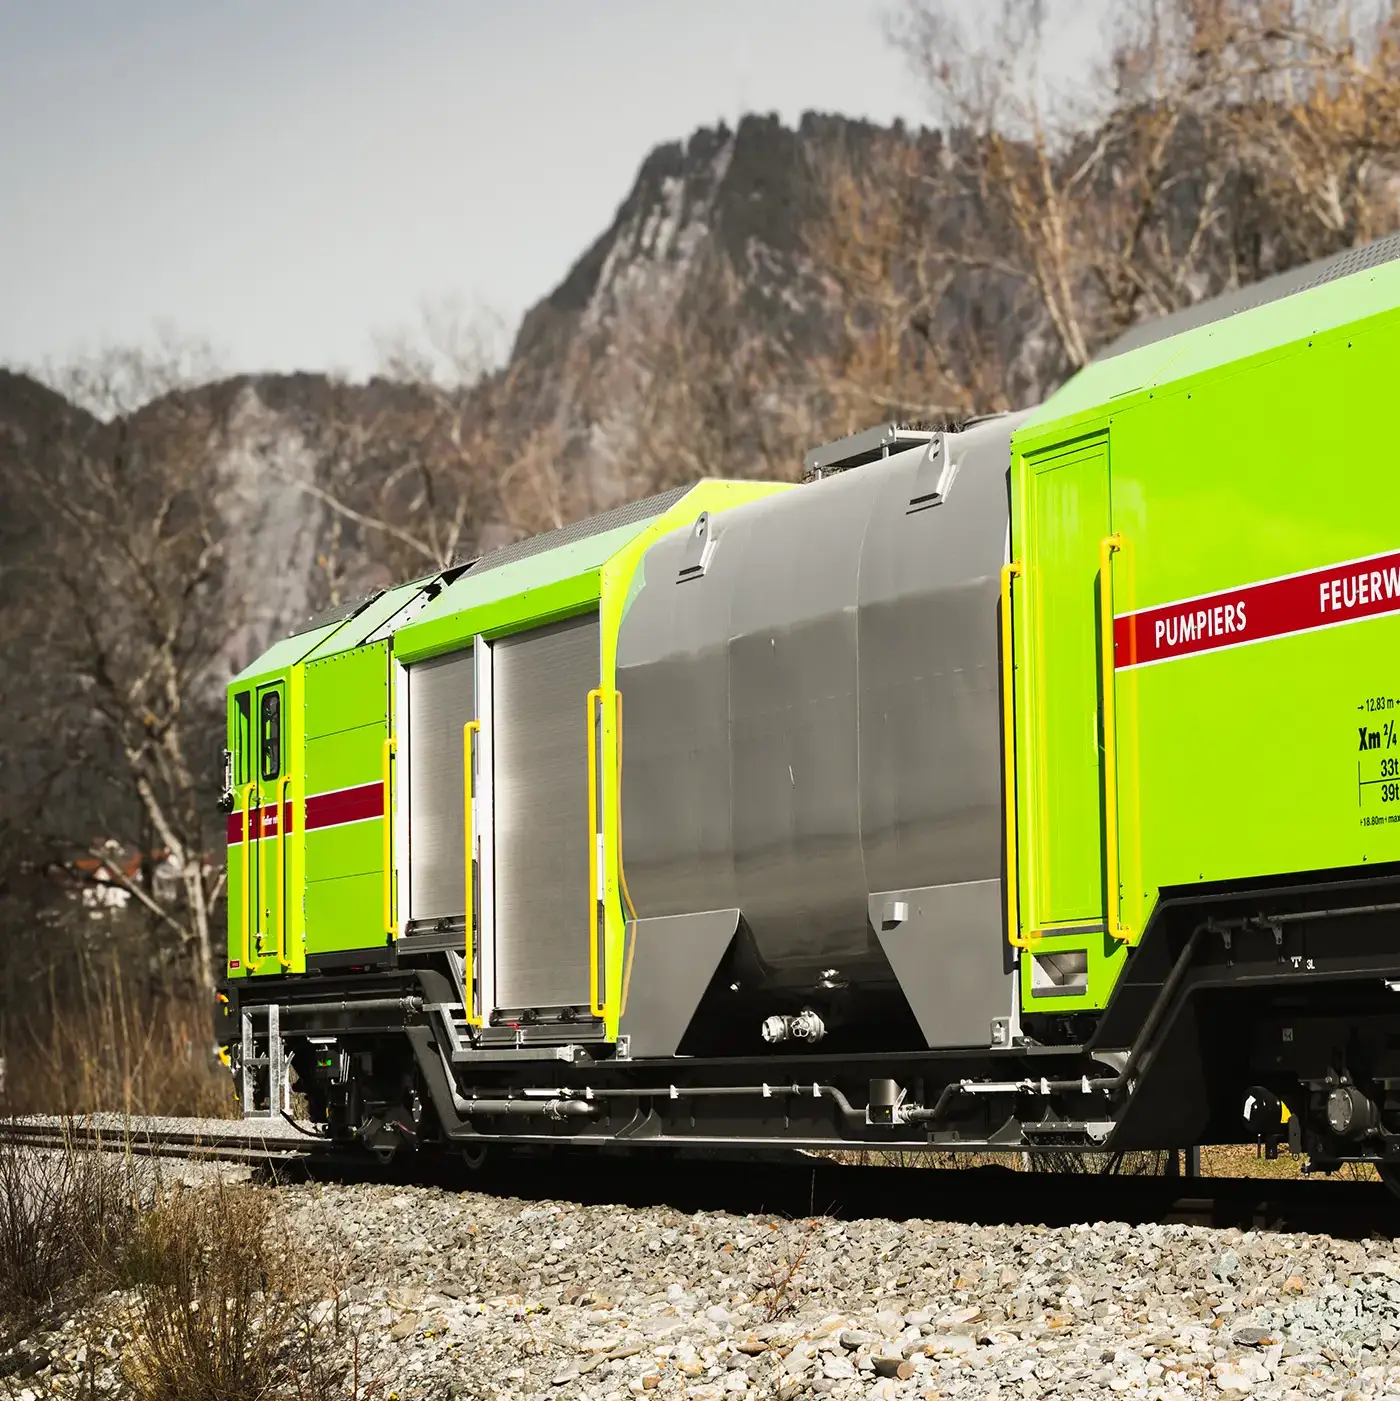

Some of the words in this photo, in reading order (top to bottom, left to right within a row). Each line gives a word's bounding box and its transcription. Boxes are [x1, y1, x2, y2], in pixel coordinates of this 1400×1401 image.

[1154, 601, 1247, 648] PUMPIERS
[1366, 696, 1386, 712] 12.83
[1386, 698, 1394, 709] m
[1358, 726, 1381, 751] Xm
[1380, 758, 1399, 777] 33t
[1381, 783, 1400, 803] 39t
[1306, 958, 1316, 970] 3L
